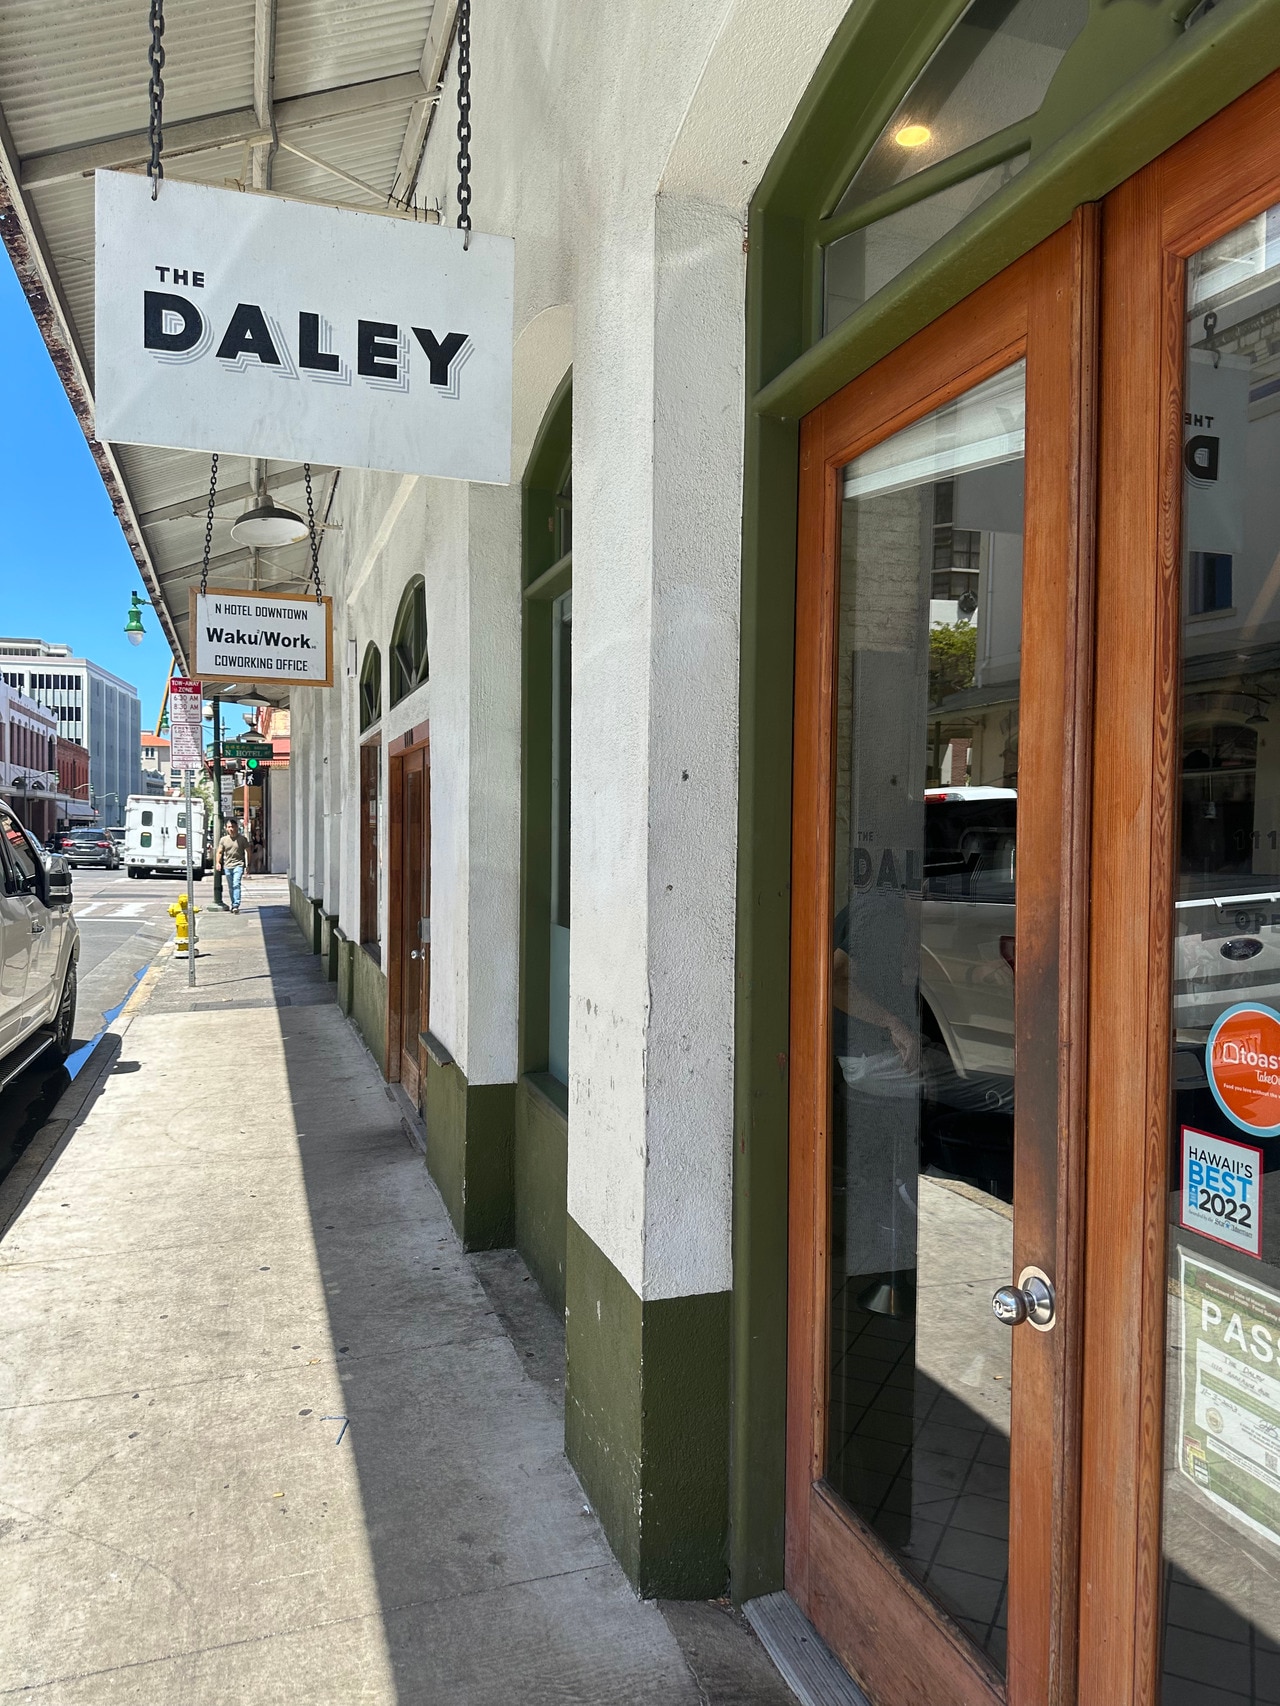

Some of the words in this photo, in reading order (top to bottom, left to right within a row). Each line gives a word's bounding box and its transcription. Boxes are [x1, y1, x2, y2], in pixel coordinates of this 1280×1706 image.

[155, 265, 205, 288] THE
[144, 290, 473, 398] DALEY
[215, 603, 222, 614] N
[224, 604, 252, 617] HOTEL
[255, 606, 308, 621] DOWNTOWN
[214, 654, 273, 670] COWORKING
[276, 659, 308, 672] OFFICE
[857, 831, 874, 842] THE
[1240, 1047, 1280, 1070] toas
[1254, 1069, 1280, 1086] TakeO
[1223, 1082, 1234, 1090] Food
[1252, 1089, 1269, 1097] without
[1189, 1145, 1253, 1179] HAWAII'S
[1188, 1159, 1253, 1203] BEST
[1199, 1188, 1252, 1229] 2022
[1202, 1298, 1280, 1368] PAS
